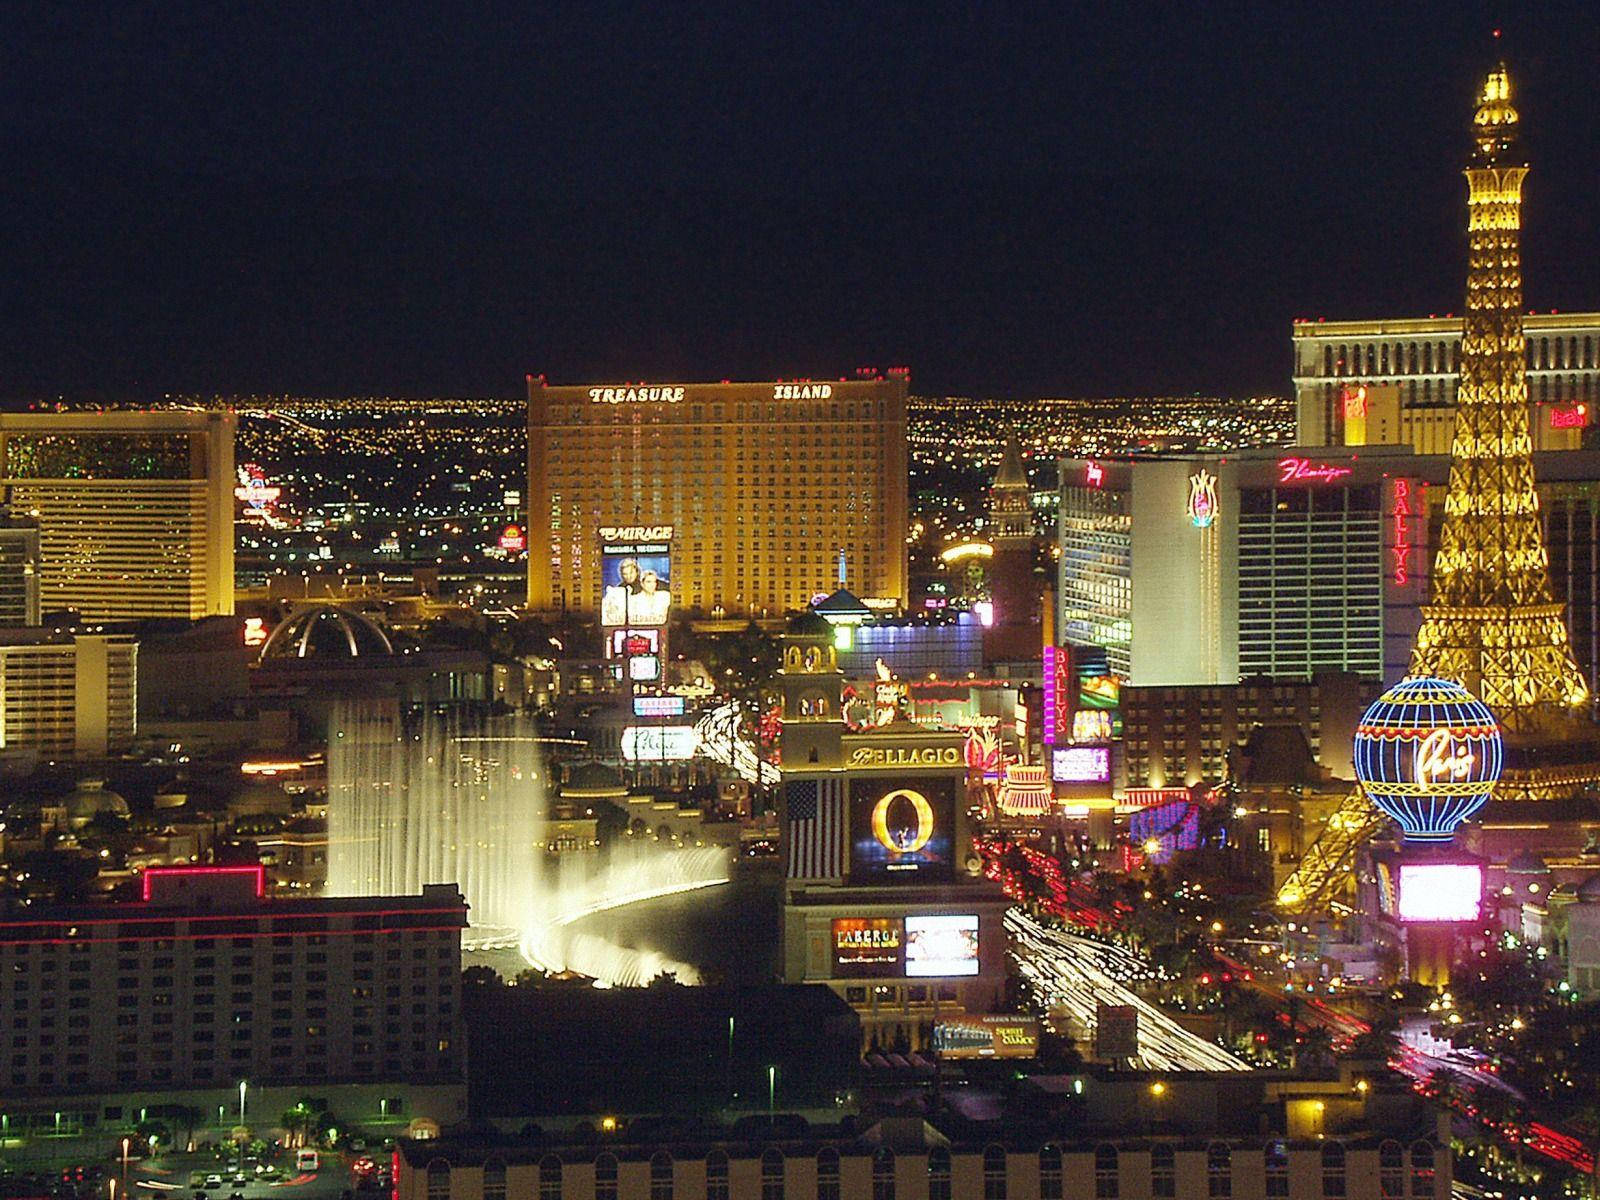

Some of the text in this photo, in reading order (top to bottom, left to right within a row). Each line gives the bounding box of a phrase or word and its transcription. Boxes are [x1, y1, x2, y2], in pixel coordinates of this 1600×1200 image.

[589, 385, 832, 403] TREASURE ISLAND
[1278, 458, 1350, 482] Flamingo
[615, 527, 673, 541] MIRAGE
[847, 747, 960, 766] BELLAGIO
[871, 789, 934, 853] O
